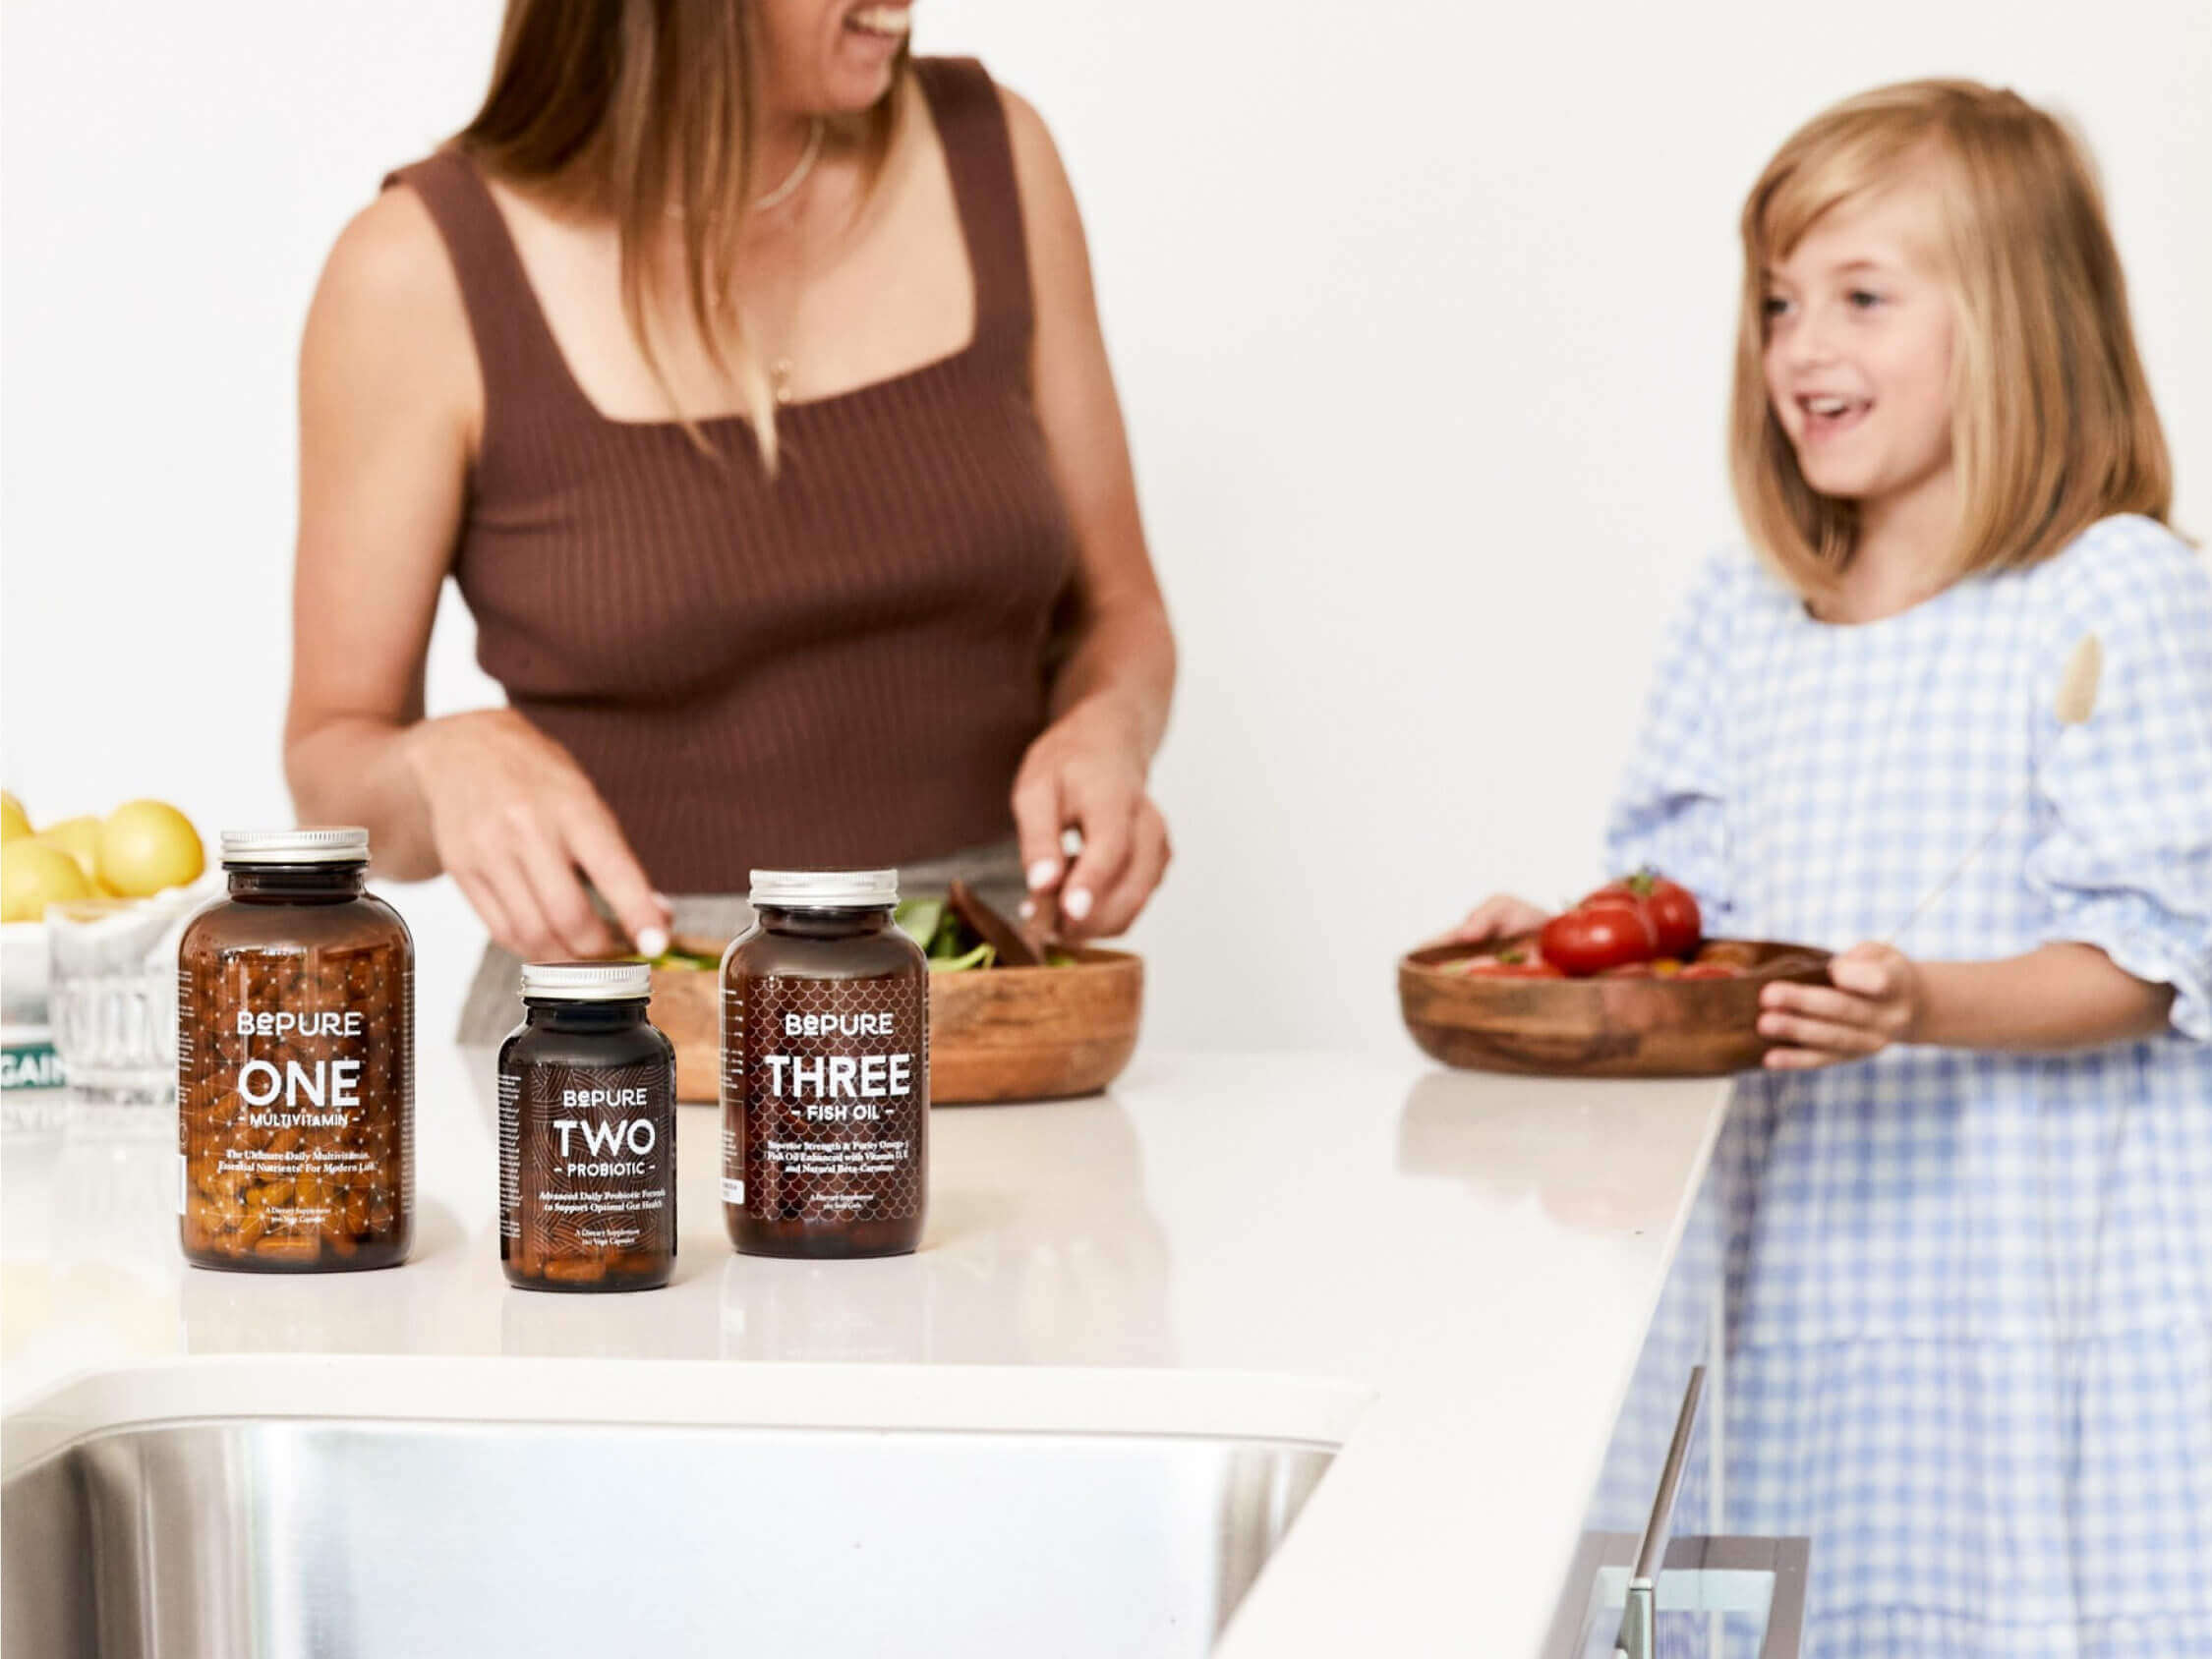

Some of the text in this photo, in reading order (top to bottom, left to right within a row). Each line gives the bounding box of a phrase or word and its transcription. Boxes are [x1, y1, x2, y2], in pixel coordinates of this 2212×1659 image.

[237, 1011, 362, 1036] BePURE
[786, 1012, 895, 1036] BePURE
[238, 1059, 361, 1107] ONE
[764, 1054, 910, 1098] THREE
[563, 1088, 648, 1107] BePURE
[250, 1114, 348, 1126] MULTIVITAMIN
[807, 1105, 880, 1120] FISH OIL
[553, 1118, 656, 1157] TWO
[567, 1162, 646, 1177] PROBIOTIC
